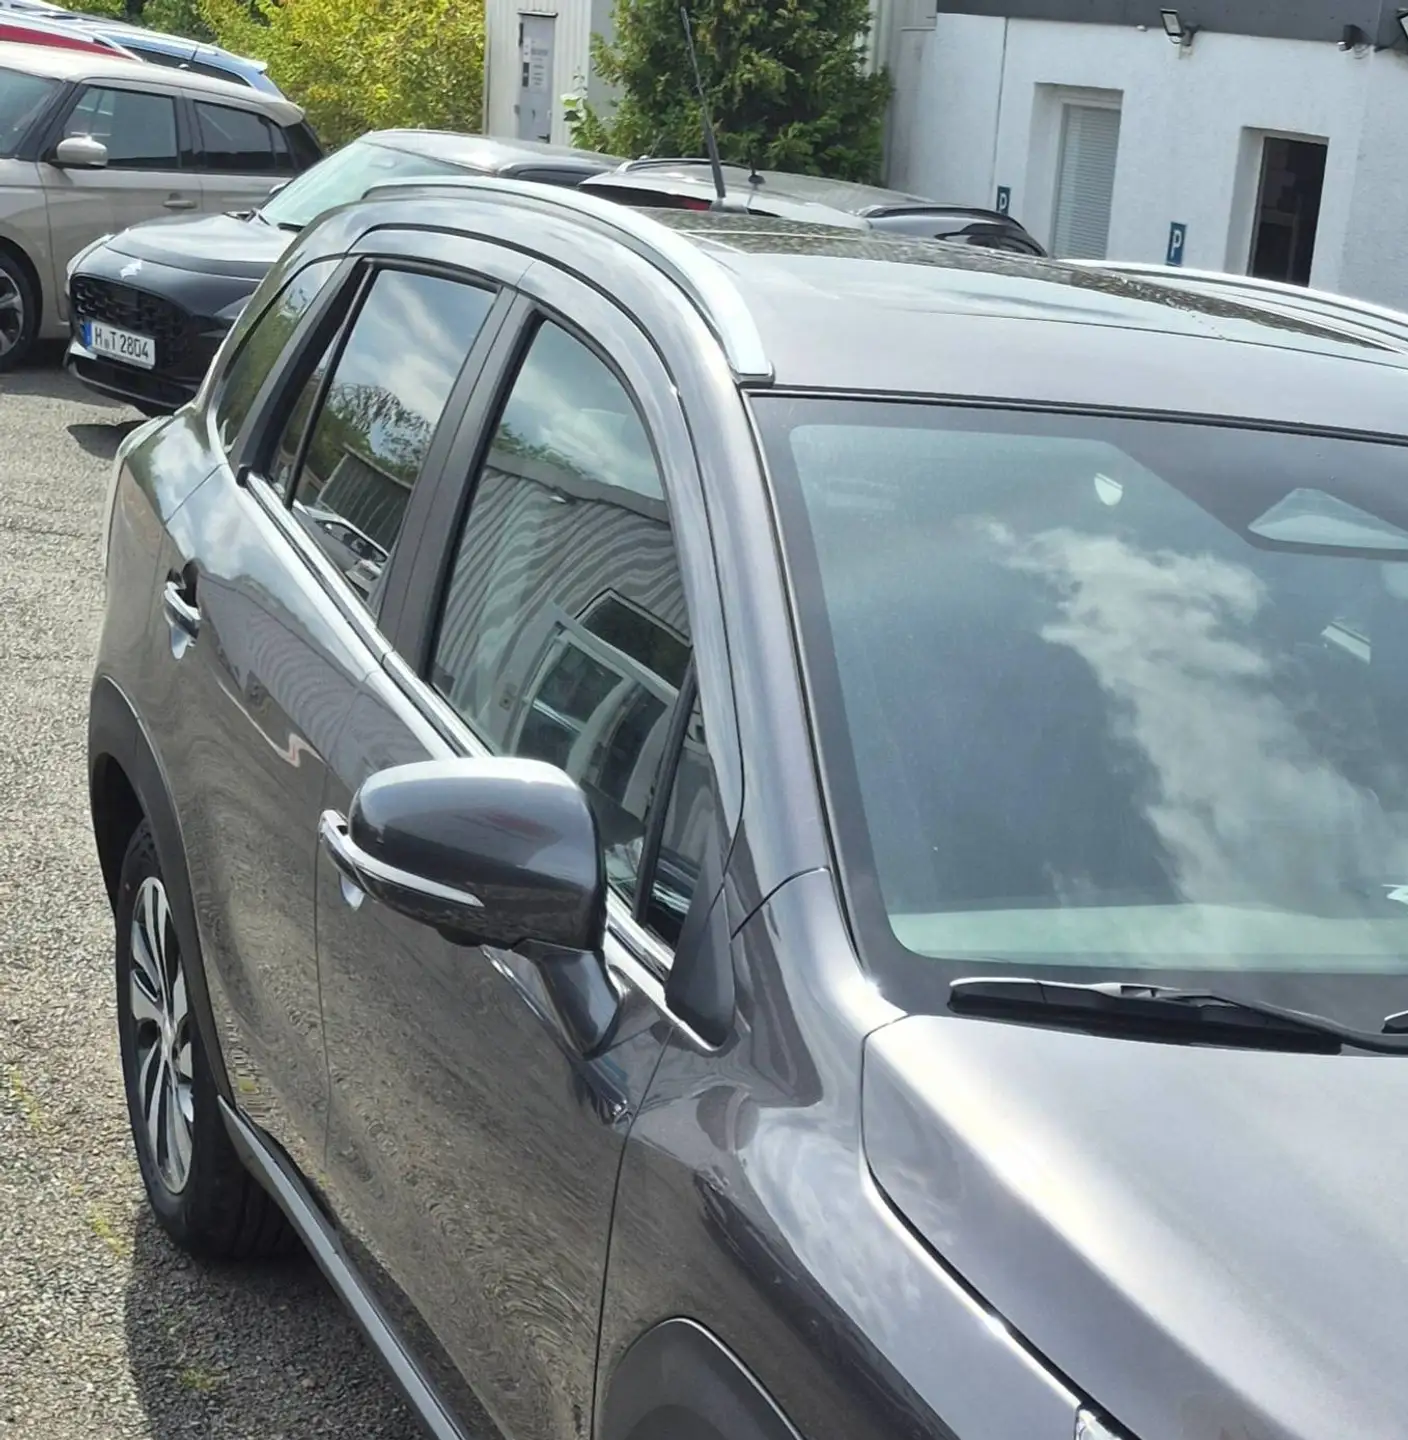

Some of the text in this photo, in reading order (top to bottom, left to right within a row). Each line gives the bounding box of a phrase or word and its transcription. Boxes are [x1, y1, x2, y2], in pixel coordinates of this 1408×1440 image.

[999, 192, 1008, 211] P
[1170, 229, 1182, 260] P
[120, 334, 149, 358] 2804
